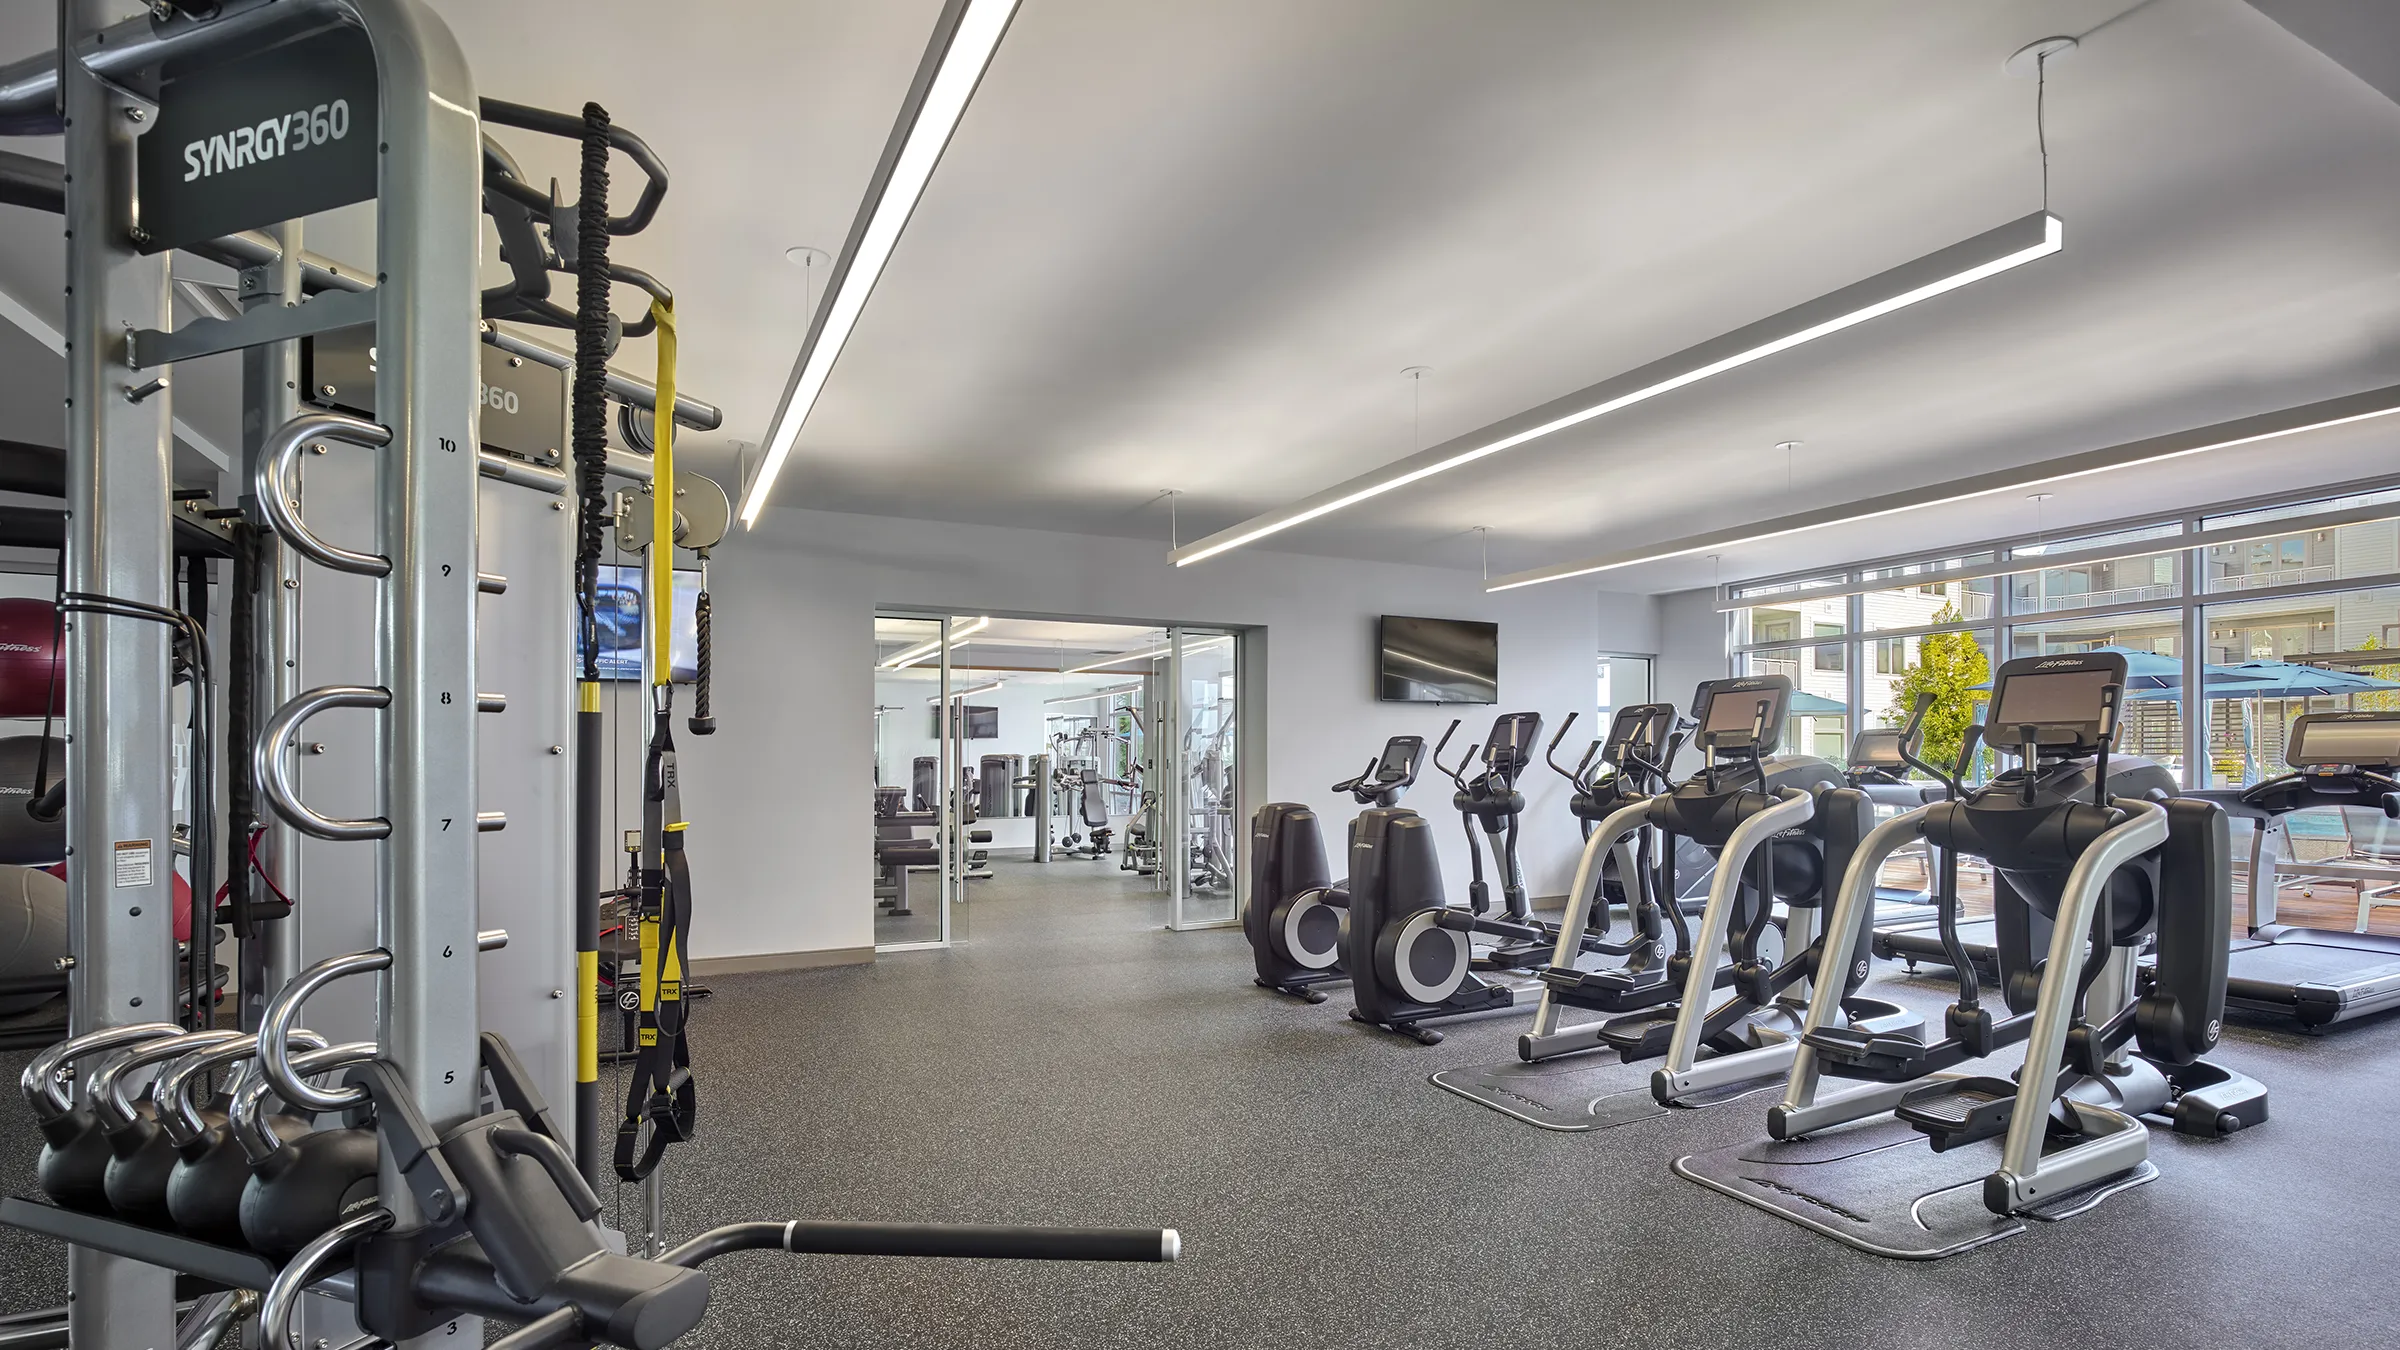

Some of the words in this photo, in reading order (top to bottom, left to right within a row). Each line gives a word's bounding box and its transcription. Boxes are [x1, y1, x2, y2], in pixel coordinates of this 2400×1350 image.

[184, 98, 350, 182] SYNRGY360
[438, 437, 456, 453] 10
[441, 564, 451, 577] 9
[440, 692, 452, 705] 8
[667, 762, 676, 789] TRX
[441, 818, 452, 832] 7
[442, 945, 453, 958] 6
[443, 1070, 455, 1084] 5
[446, 1321, 458, 1336] 3
